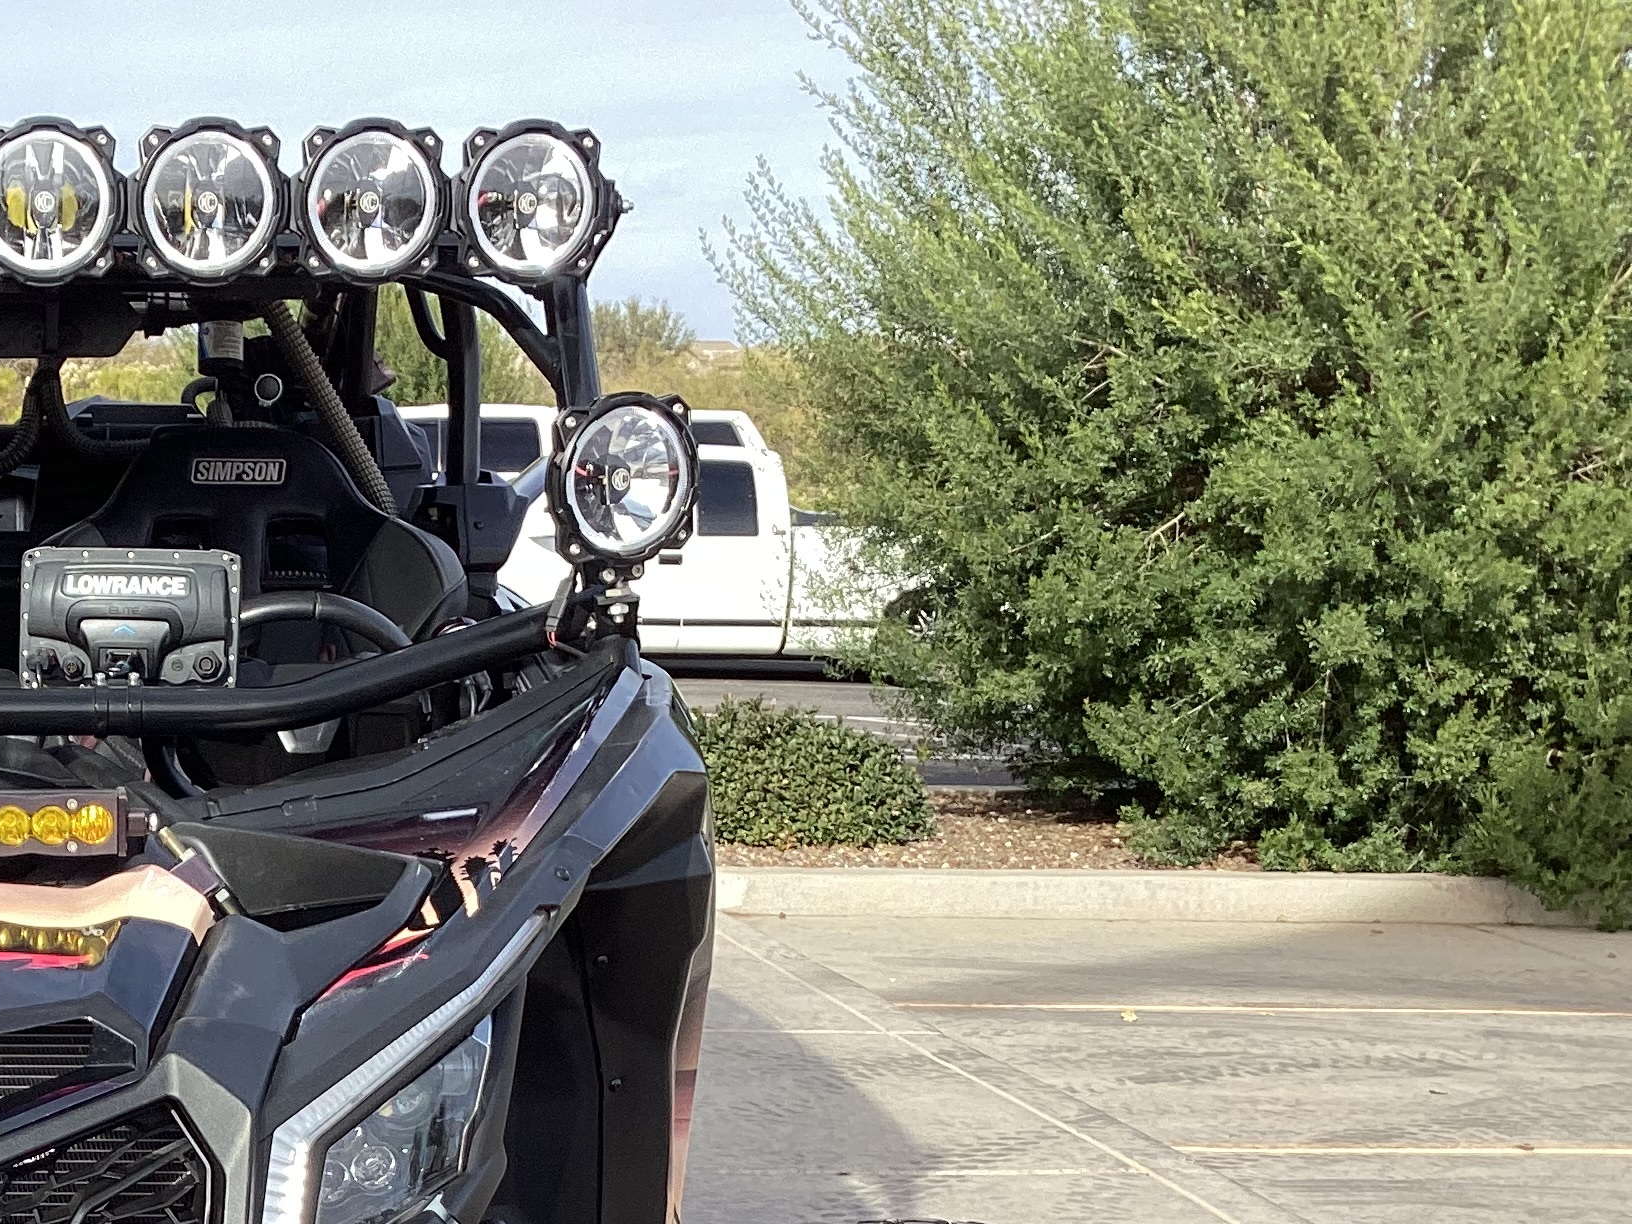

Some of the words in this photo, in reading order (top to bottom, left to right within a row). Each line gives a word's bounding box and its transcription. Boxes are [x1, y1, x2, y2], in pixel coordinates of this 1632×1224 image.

[198, 192, 217, 212] KC
[360, 193, 378, 212] KC
[519, 193, 537, 213] KC
[196, 461, 280, 481] SIMPSON
[612, 468, 630, 490] KC
[66, 574, 187, 596] LOWRANCE
